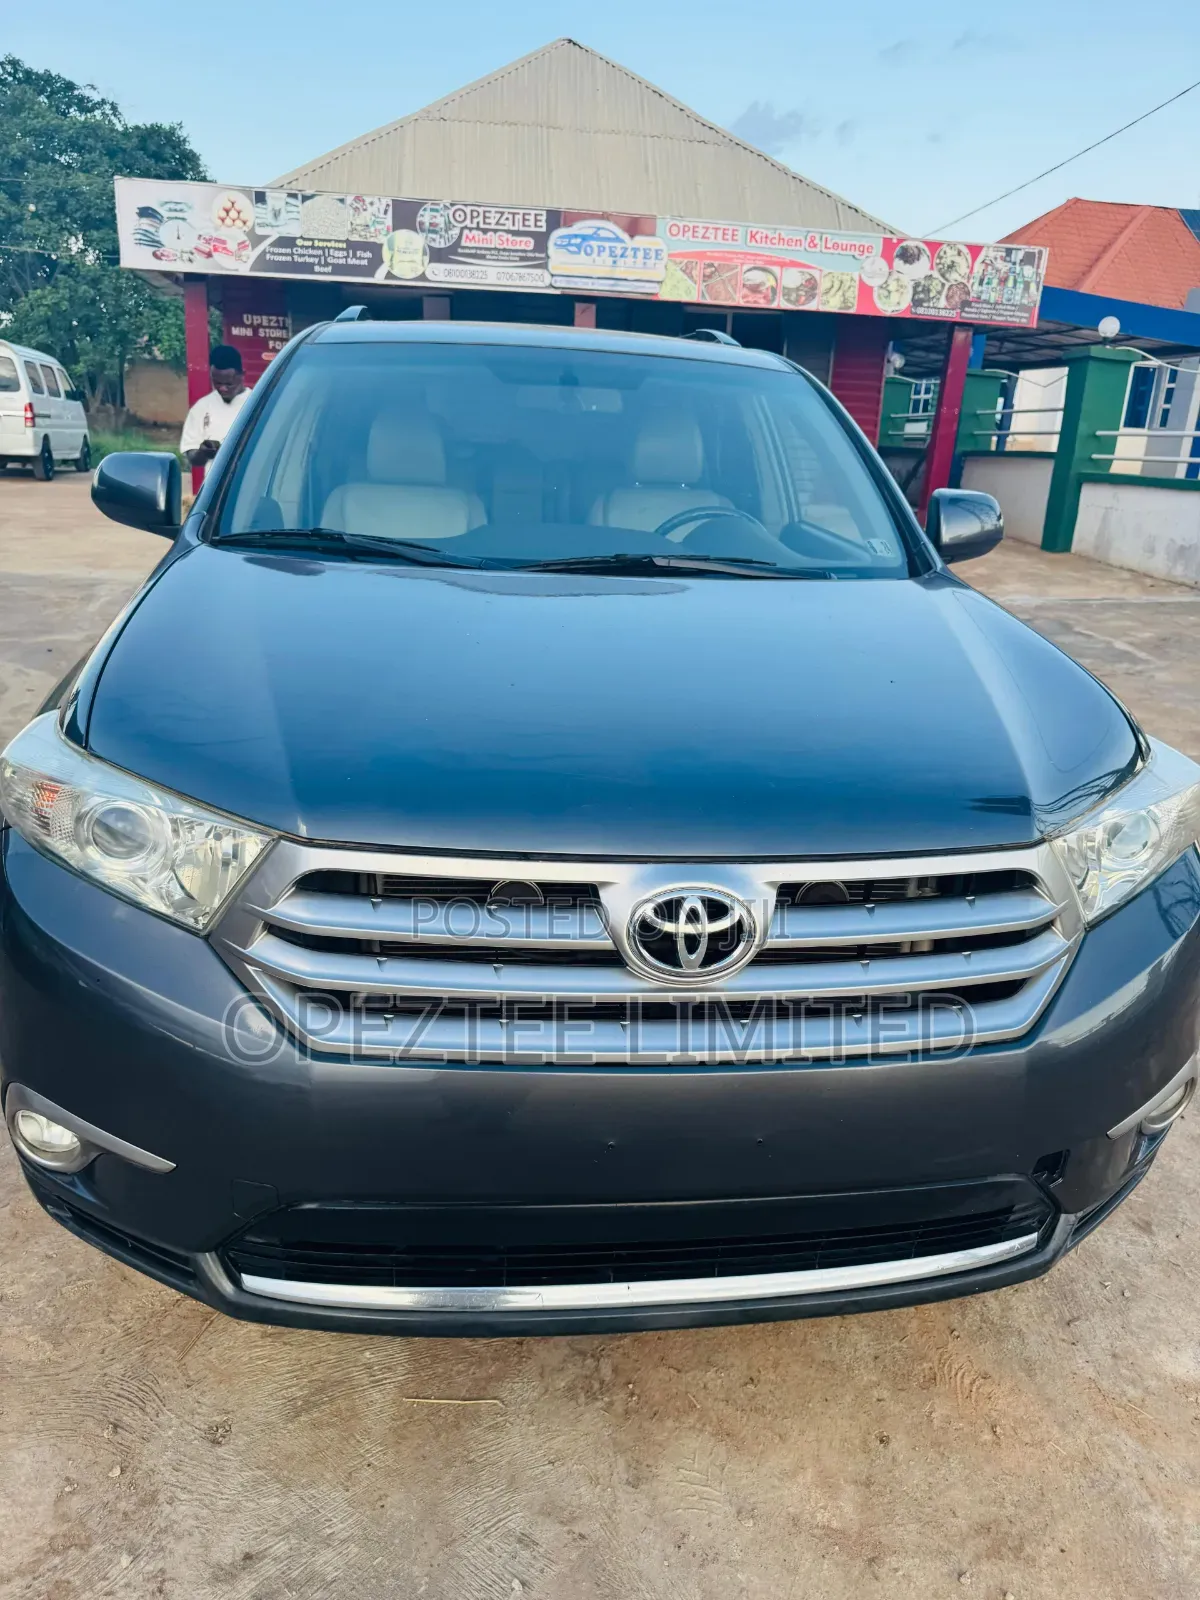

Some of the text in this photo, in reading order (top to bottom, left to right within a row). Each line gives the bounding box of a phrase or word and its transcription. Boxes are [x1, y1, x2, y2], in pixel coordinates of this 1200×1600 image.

[451, 206, 545, 229] OPEZTEE
[295, 239, 347, 249] Our Services
[463, 231, 532, 248] Mini Store
[668, 223, 874, 256] OPEZTEE Kitchen & Lounge
[265, 246, 373, 259] Frozen Chicken Eggs Fish
[583, 243, 664, 261] OPEZTEE
[265, 253, 368, 266] Frozen Turkey Goat Meat
[314, 265, 332, 273] Beef
[231, 326, 253, 337] MINI
